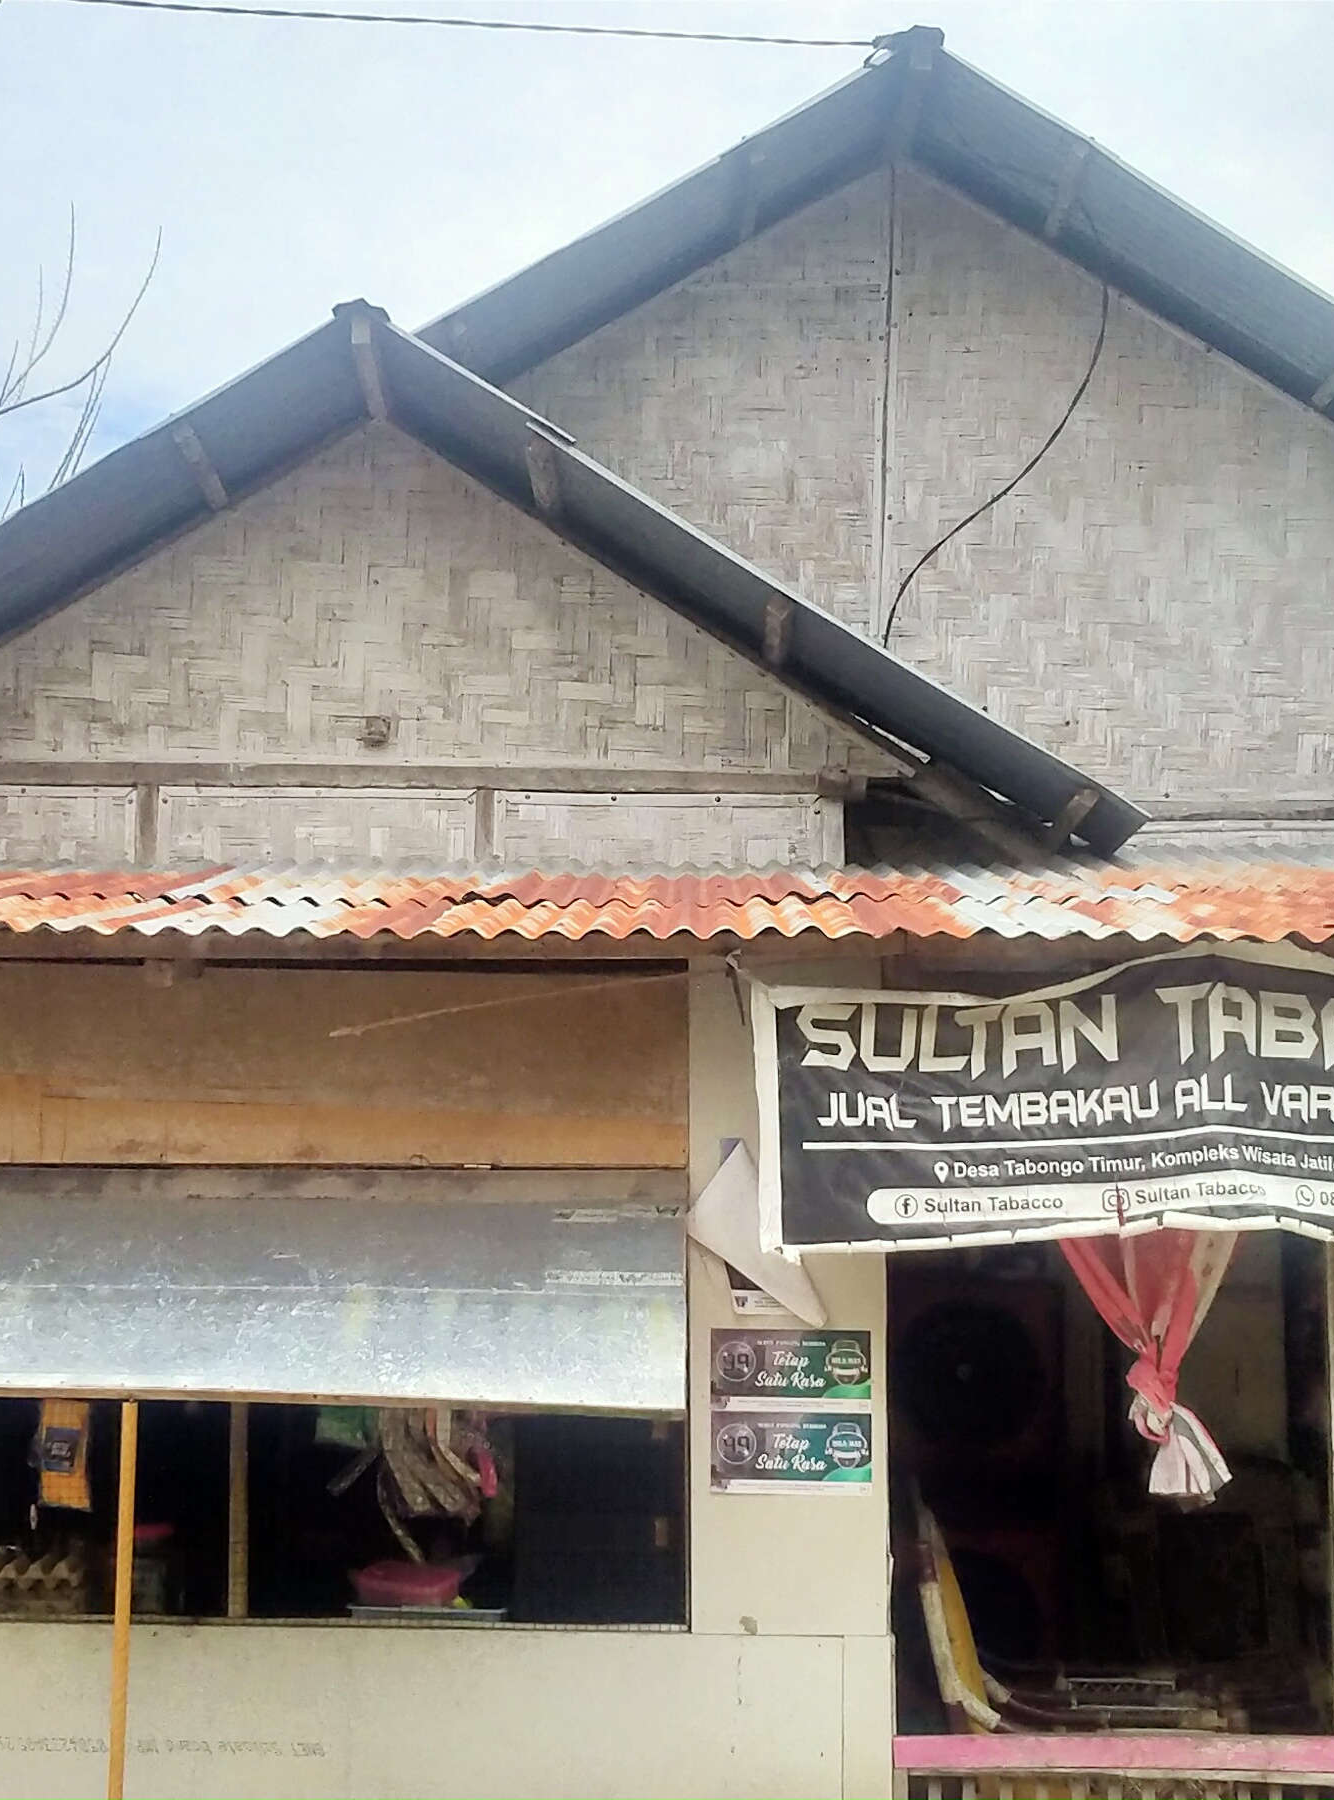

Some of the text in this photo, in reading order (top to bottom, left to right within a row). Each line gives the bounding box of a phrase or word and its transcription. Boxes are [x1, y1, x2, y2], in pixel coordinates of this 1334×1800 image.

[796, 994, 1120, 1080] SULTAN
[817, 1091, 918, 1132] JUAL
[931, 1079, 1160, 1133] TEMBAKAU
[1174, 1073, 1248, 1120] ALL
[953, 1161, 1000, 1179] Desa
[1003, 1158, 1084, 1178] Tabongo
[1087, 1155, 1147, 1173] Timur,
[1151, 1144, 1240, 1168] Kompleks
[1241, 1145, 1297, 1168] Wisata
[1135, 1181, 1267, 1205] Sultan Tabacco
[924, 1195, 1064, 1214] Sultan Tabacco
[771, 1350, 811, 1372] Tetap
[754, 1370, 827, 1391] Satu Rasa
[772, 1432, 811, 1454] Tetap
[754, 1453, 828, 1474] Satu Rasa
